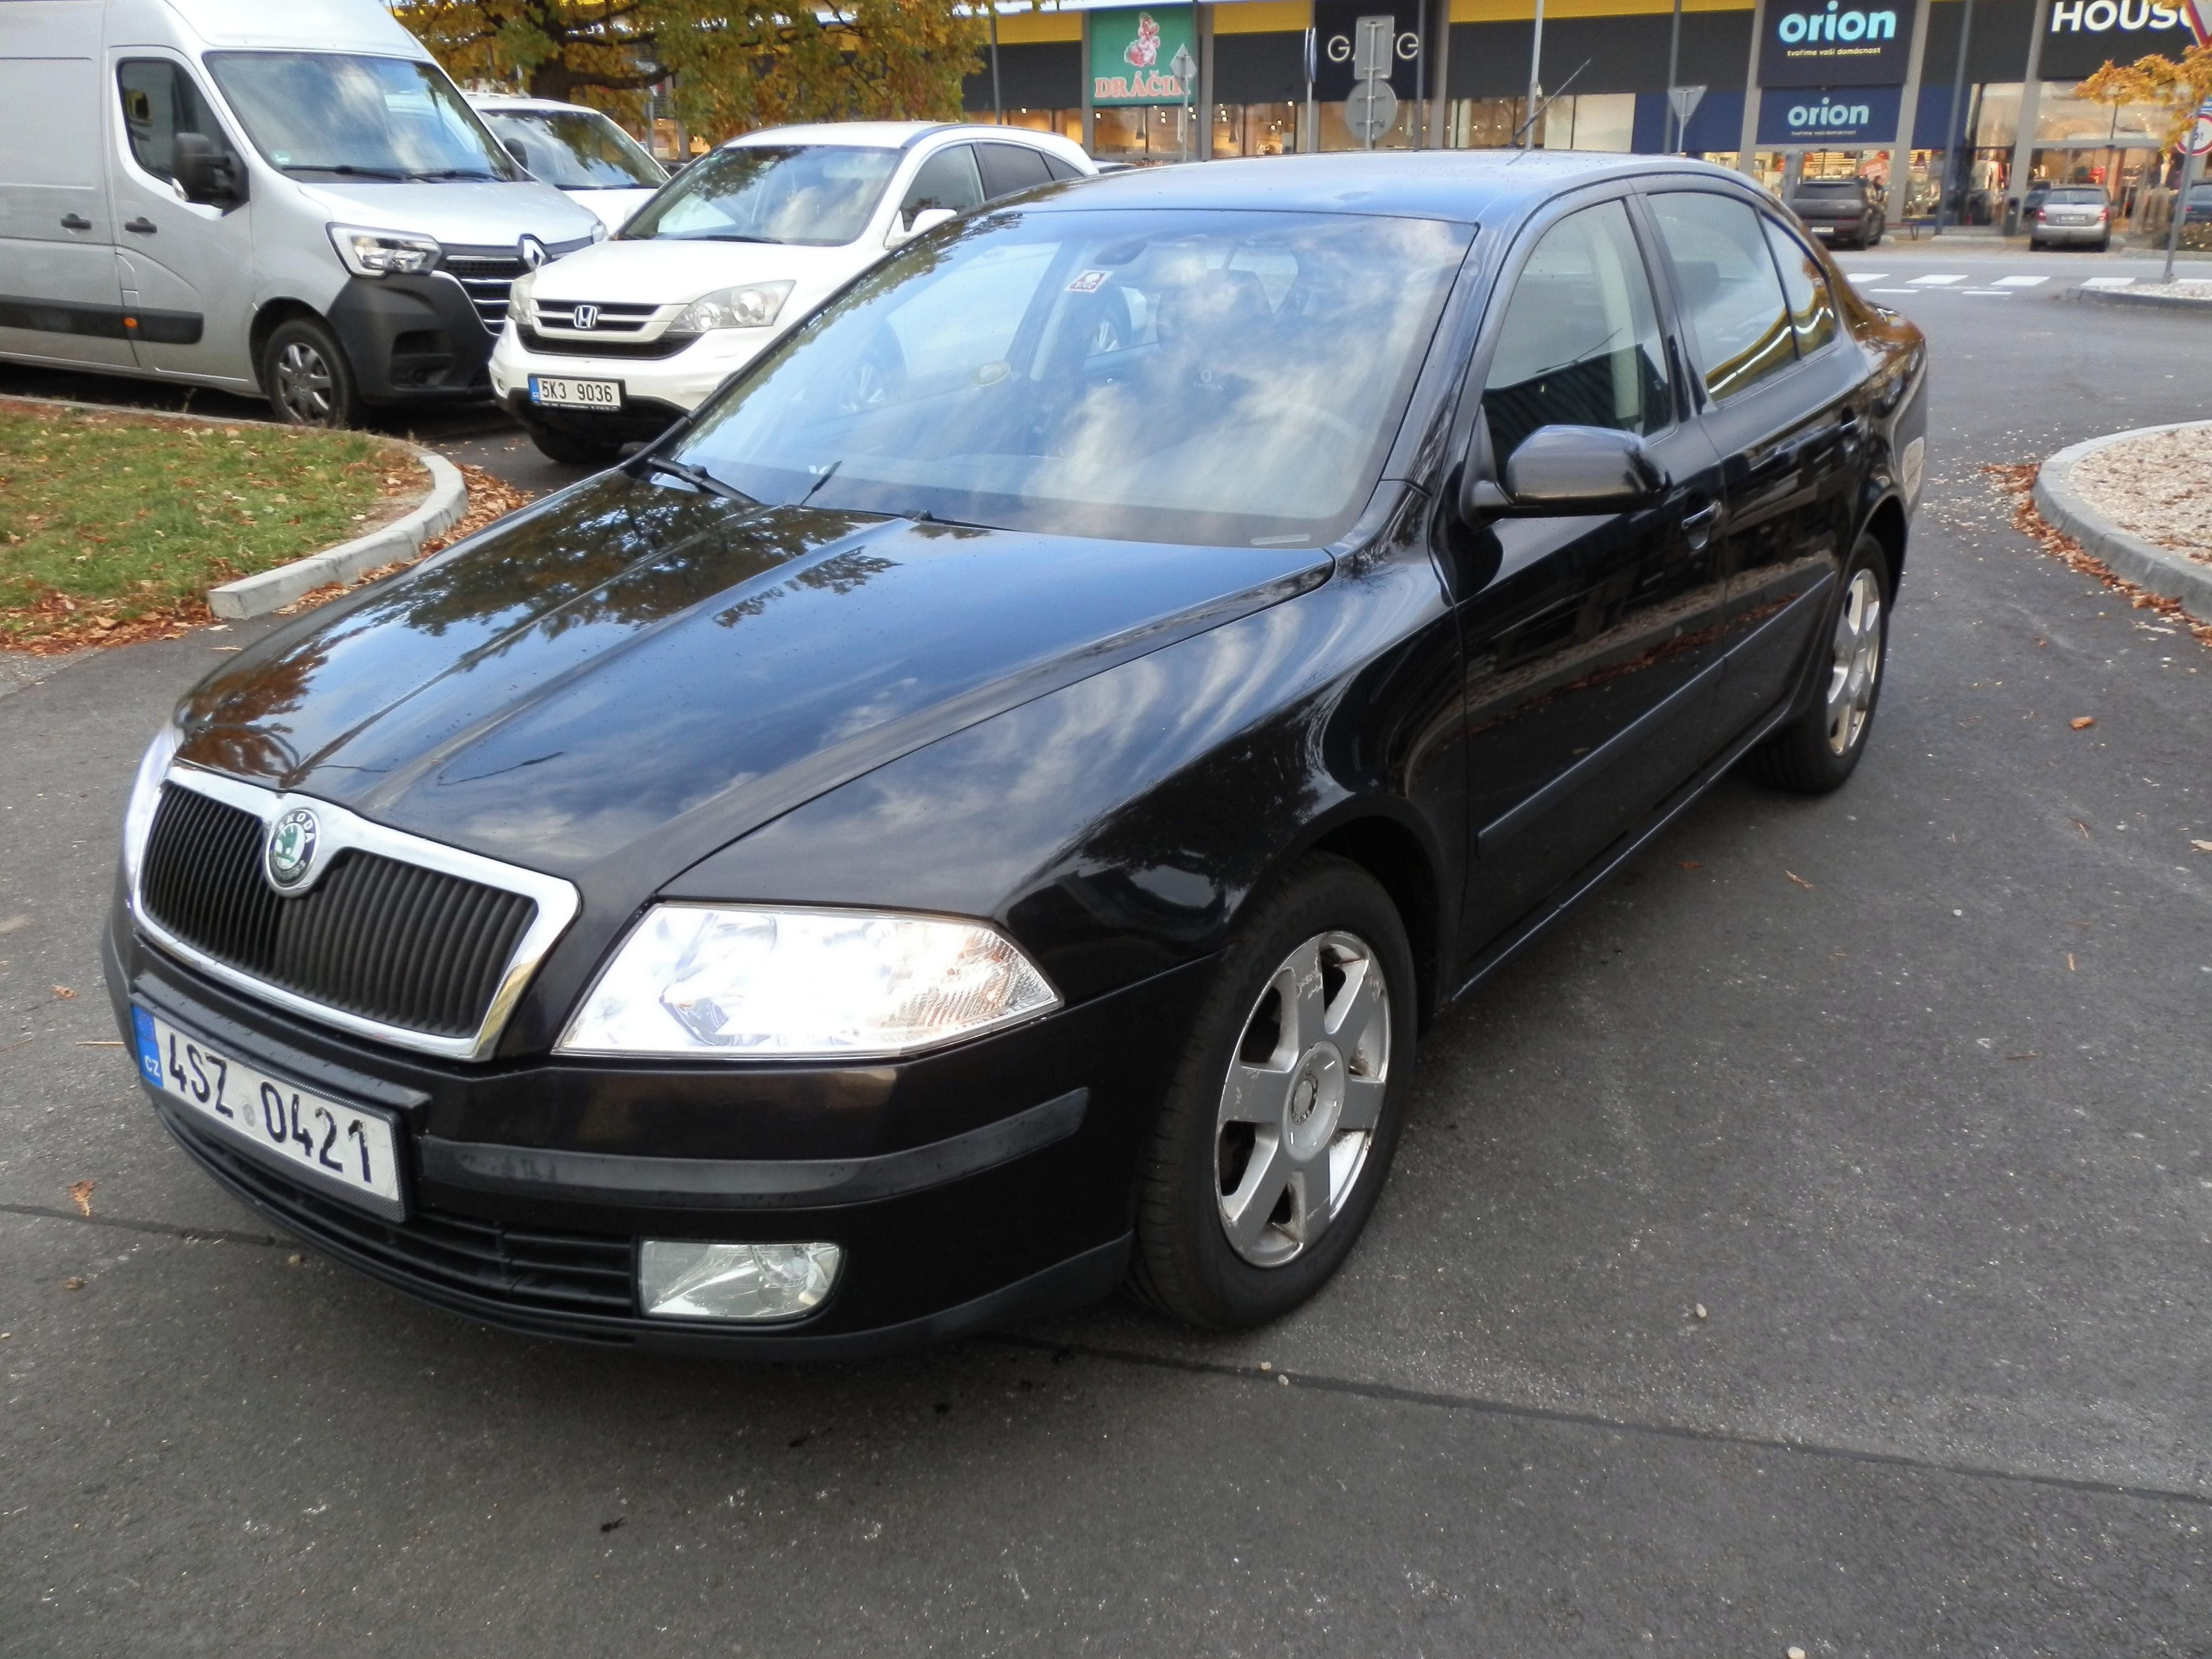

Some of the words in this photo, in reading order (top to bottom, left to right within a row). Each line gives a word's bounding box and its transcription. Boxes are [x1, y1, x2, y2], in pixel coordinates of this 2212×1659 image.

[1779, 0, 1897, 43] orion
[1788, 97, 1870, 126] orion
[542, 380, 567, 400] 5K3
[577, 383, 612, 402] 9036
[145, 1055, 160, 1077] CZ
[169, 1032, 233, 1119] 4SZ
[260, 1081, 372, 1183] 0421
